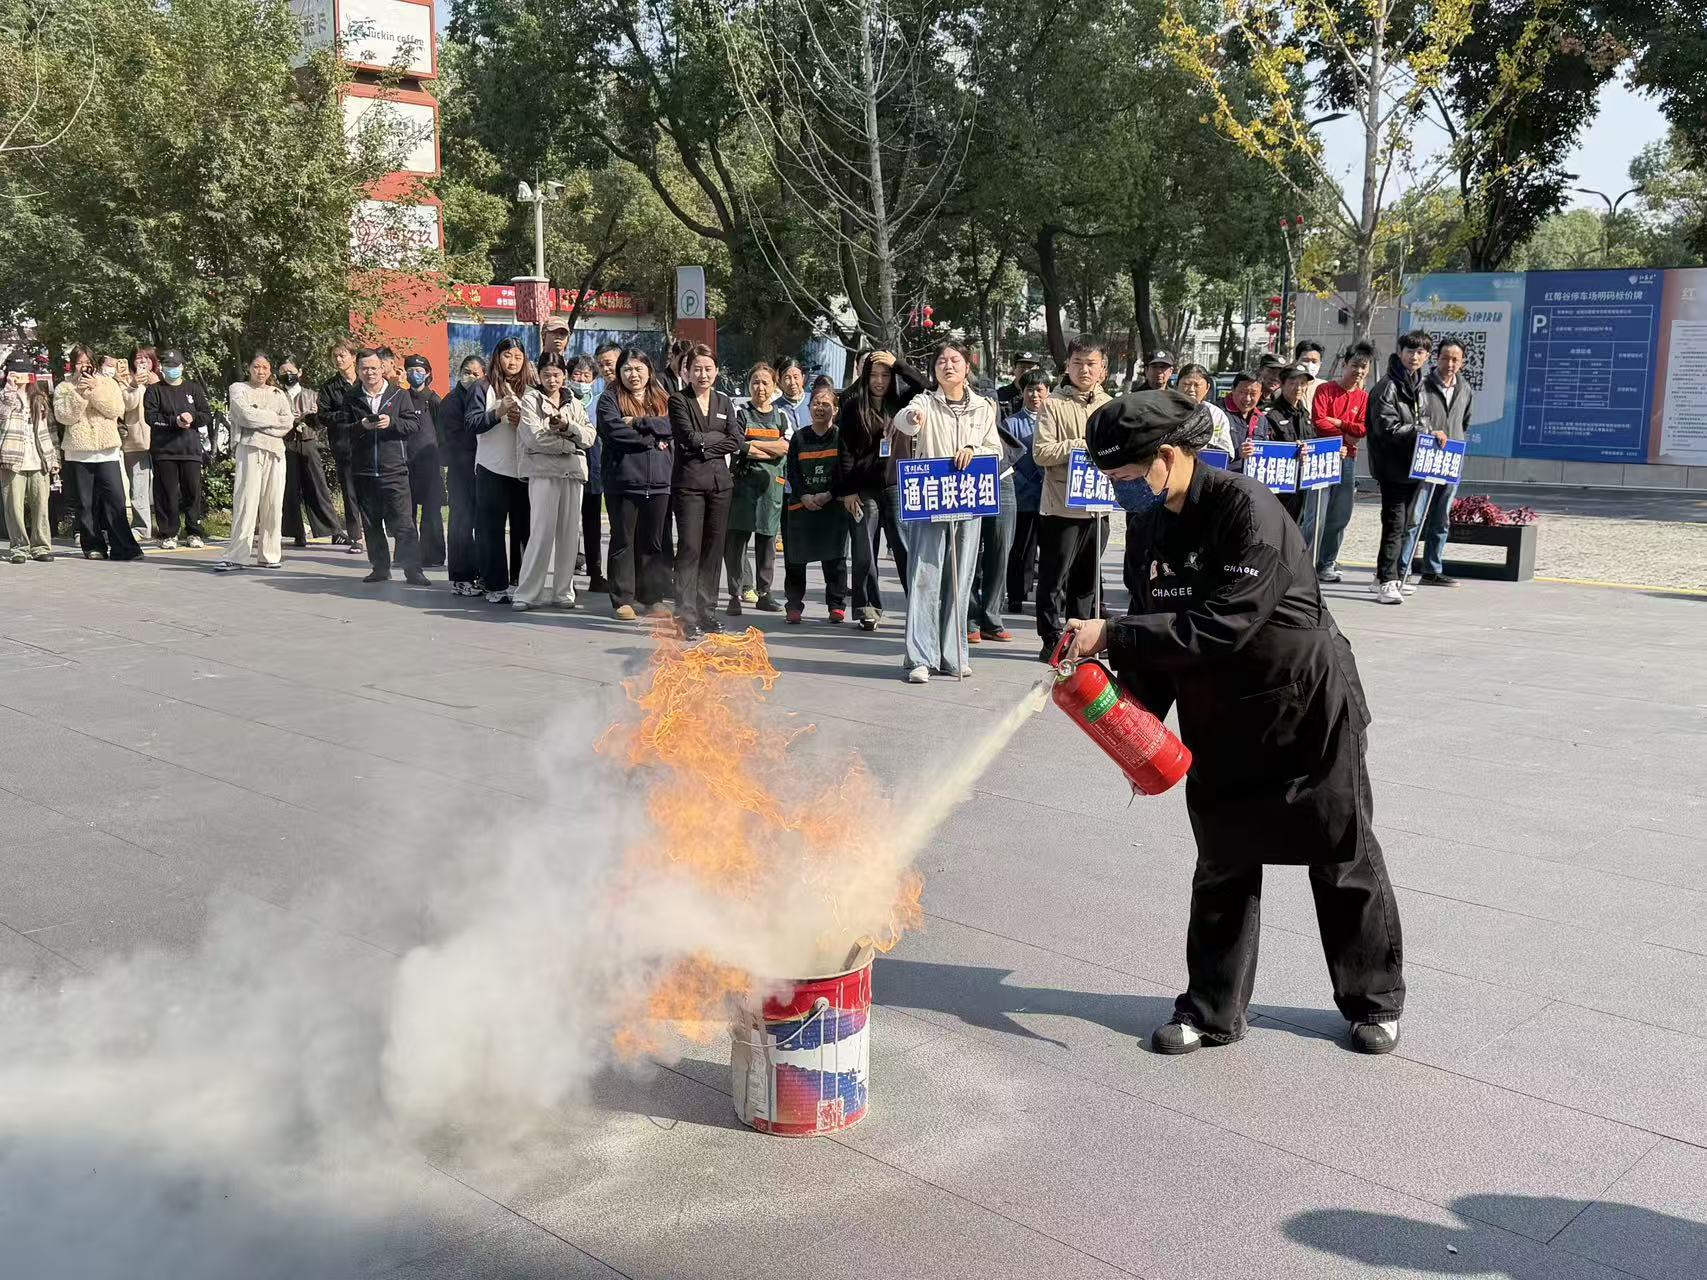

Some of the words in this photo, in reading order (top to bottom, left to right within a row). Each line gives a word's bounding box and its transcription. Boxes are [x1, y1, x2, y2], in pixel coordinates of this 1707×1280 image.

[686, 295, 695, 313] P
[1532, 314, 1547, 334] P
[1247, 456, 1297, 485] 设备保障组
[1413, 447, 1461, 478] 消防维保组
[903, 473, 997, 511] 通信联络组
[1223, 564, 1260, 577] CHAGEE
[1151, 586, 1193, 598] CHAGEE
